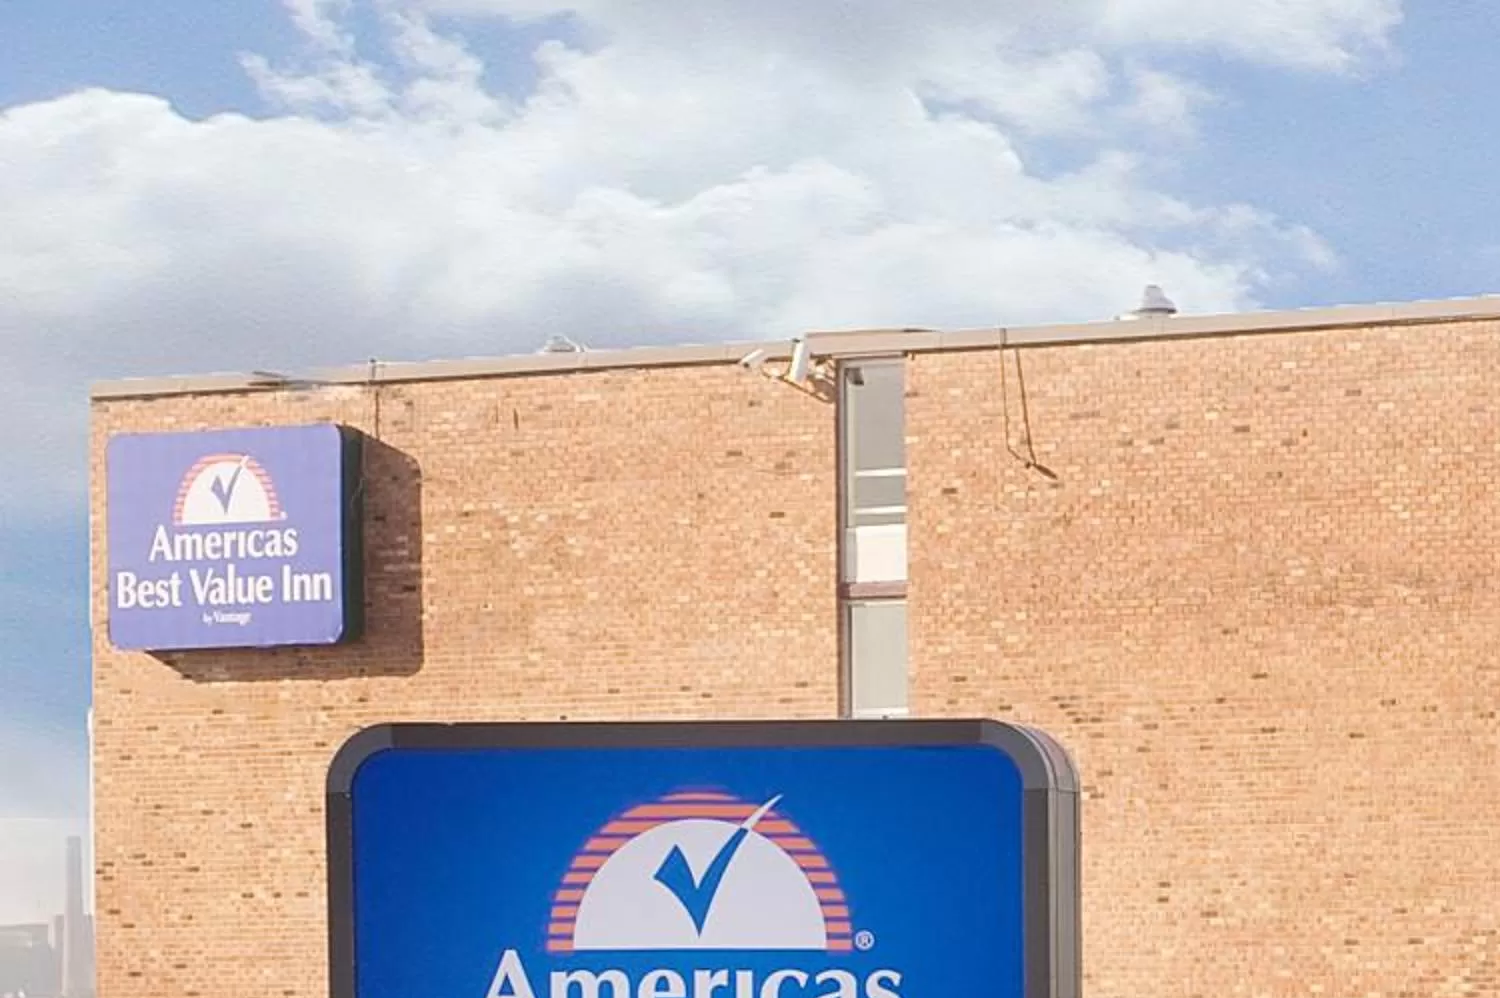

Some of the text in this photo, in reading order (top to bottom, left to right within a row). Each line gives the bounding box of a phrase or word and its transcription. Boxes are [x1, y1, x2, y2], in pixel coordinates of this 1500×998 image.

[149, 525, 298, 561] Americas
[117, 564, 332, 608] Best Value Inn
